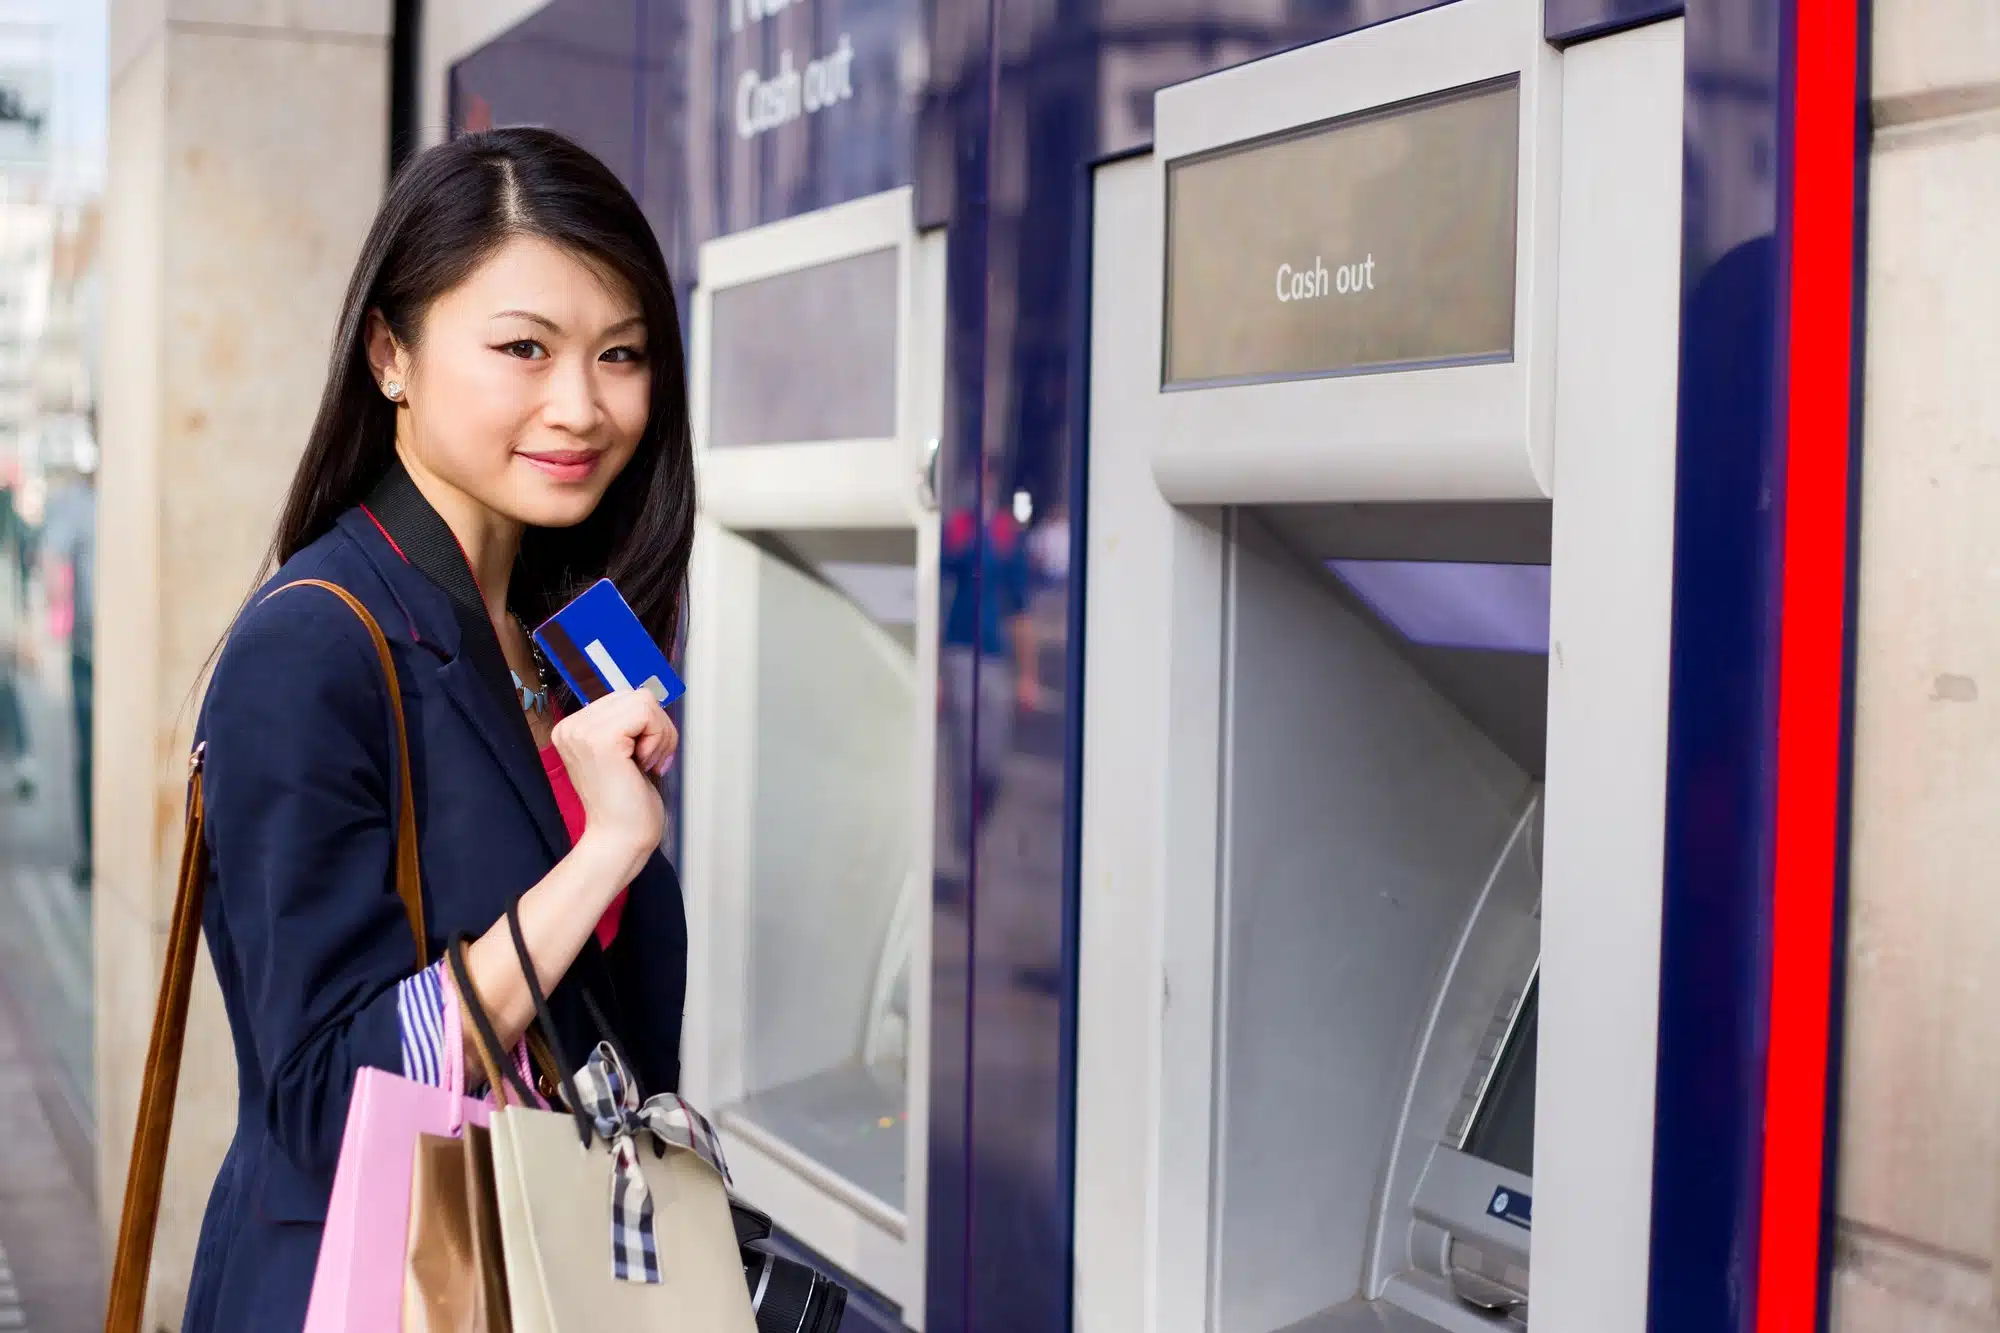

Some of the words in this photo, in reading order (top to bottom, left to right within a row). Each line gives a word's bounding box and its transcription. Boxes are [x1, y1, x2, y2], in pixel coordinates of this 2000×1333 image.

[736, 49, 801, 140] Cash
[803, 33, 853, 112] out
[1276, 255, 1329, 302] Cash
[1336, 252, 1375, 294] out
